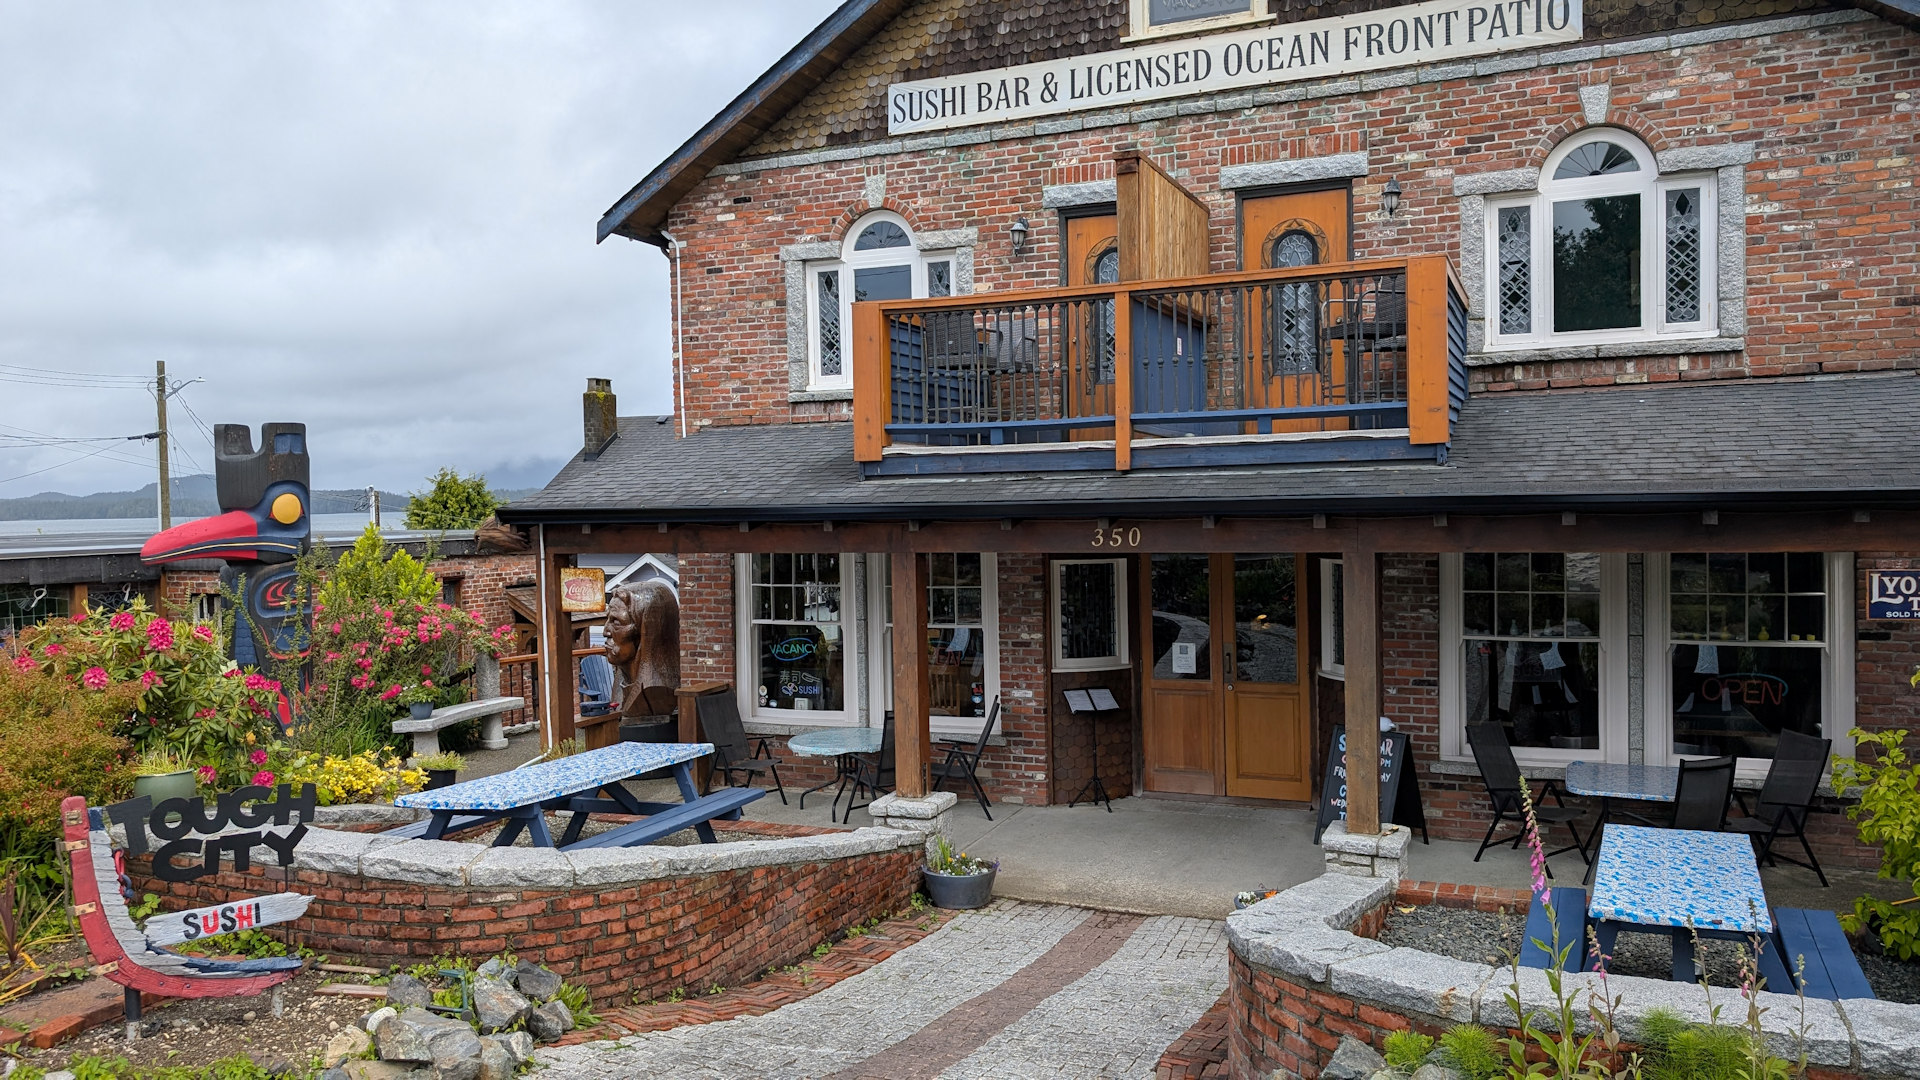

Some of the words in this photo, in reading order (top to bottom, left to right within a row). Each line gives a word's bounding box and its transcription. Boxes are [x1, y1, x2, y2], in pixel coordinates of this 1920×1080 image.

[893, 85, 967, 124] SUSHI
[976, 76, 1031, 113] BAR
[1040, 71, 1059, 104] &
[1069, 48, 1212, 100] LICENSED
[1223, 30, 1330, 77] OCEAN
[1344, 10, 1459, 60] FRONT
[1467, 0, 1570, 43] PATIO
[1091, 526, 1141, 547] 350
[1870, 573, 1920, 604] LYO
[769, 643, 818, 655] VACANCY
[798, 685, 820, 695] SUSHI
[1702, 676, 1784, 706] OPEN
[106, 782, 316, 858] TOUGH
[152, 823, 309, 882] CITY
[183, 902, 262, 940] SUSHI
